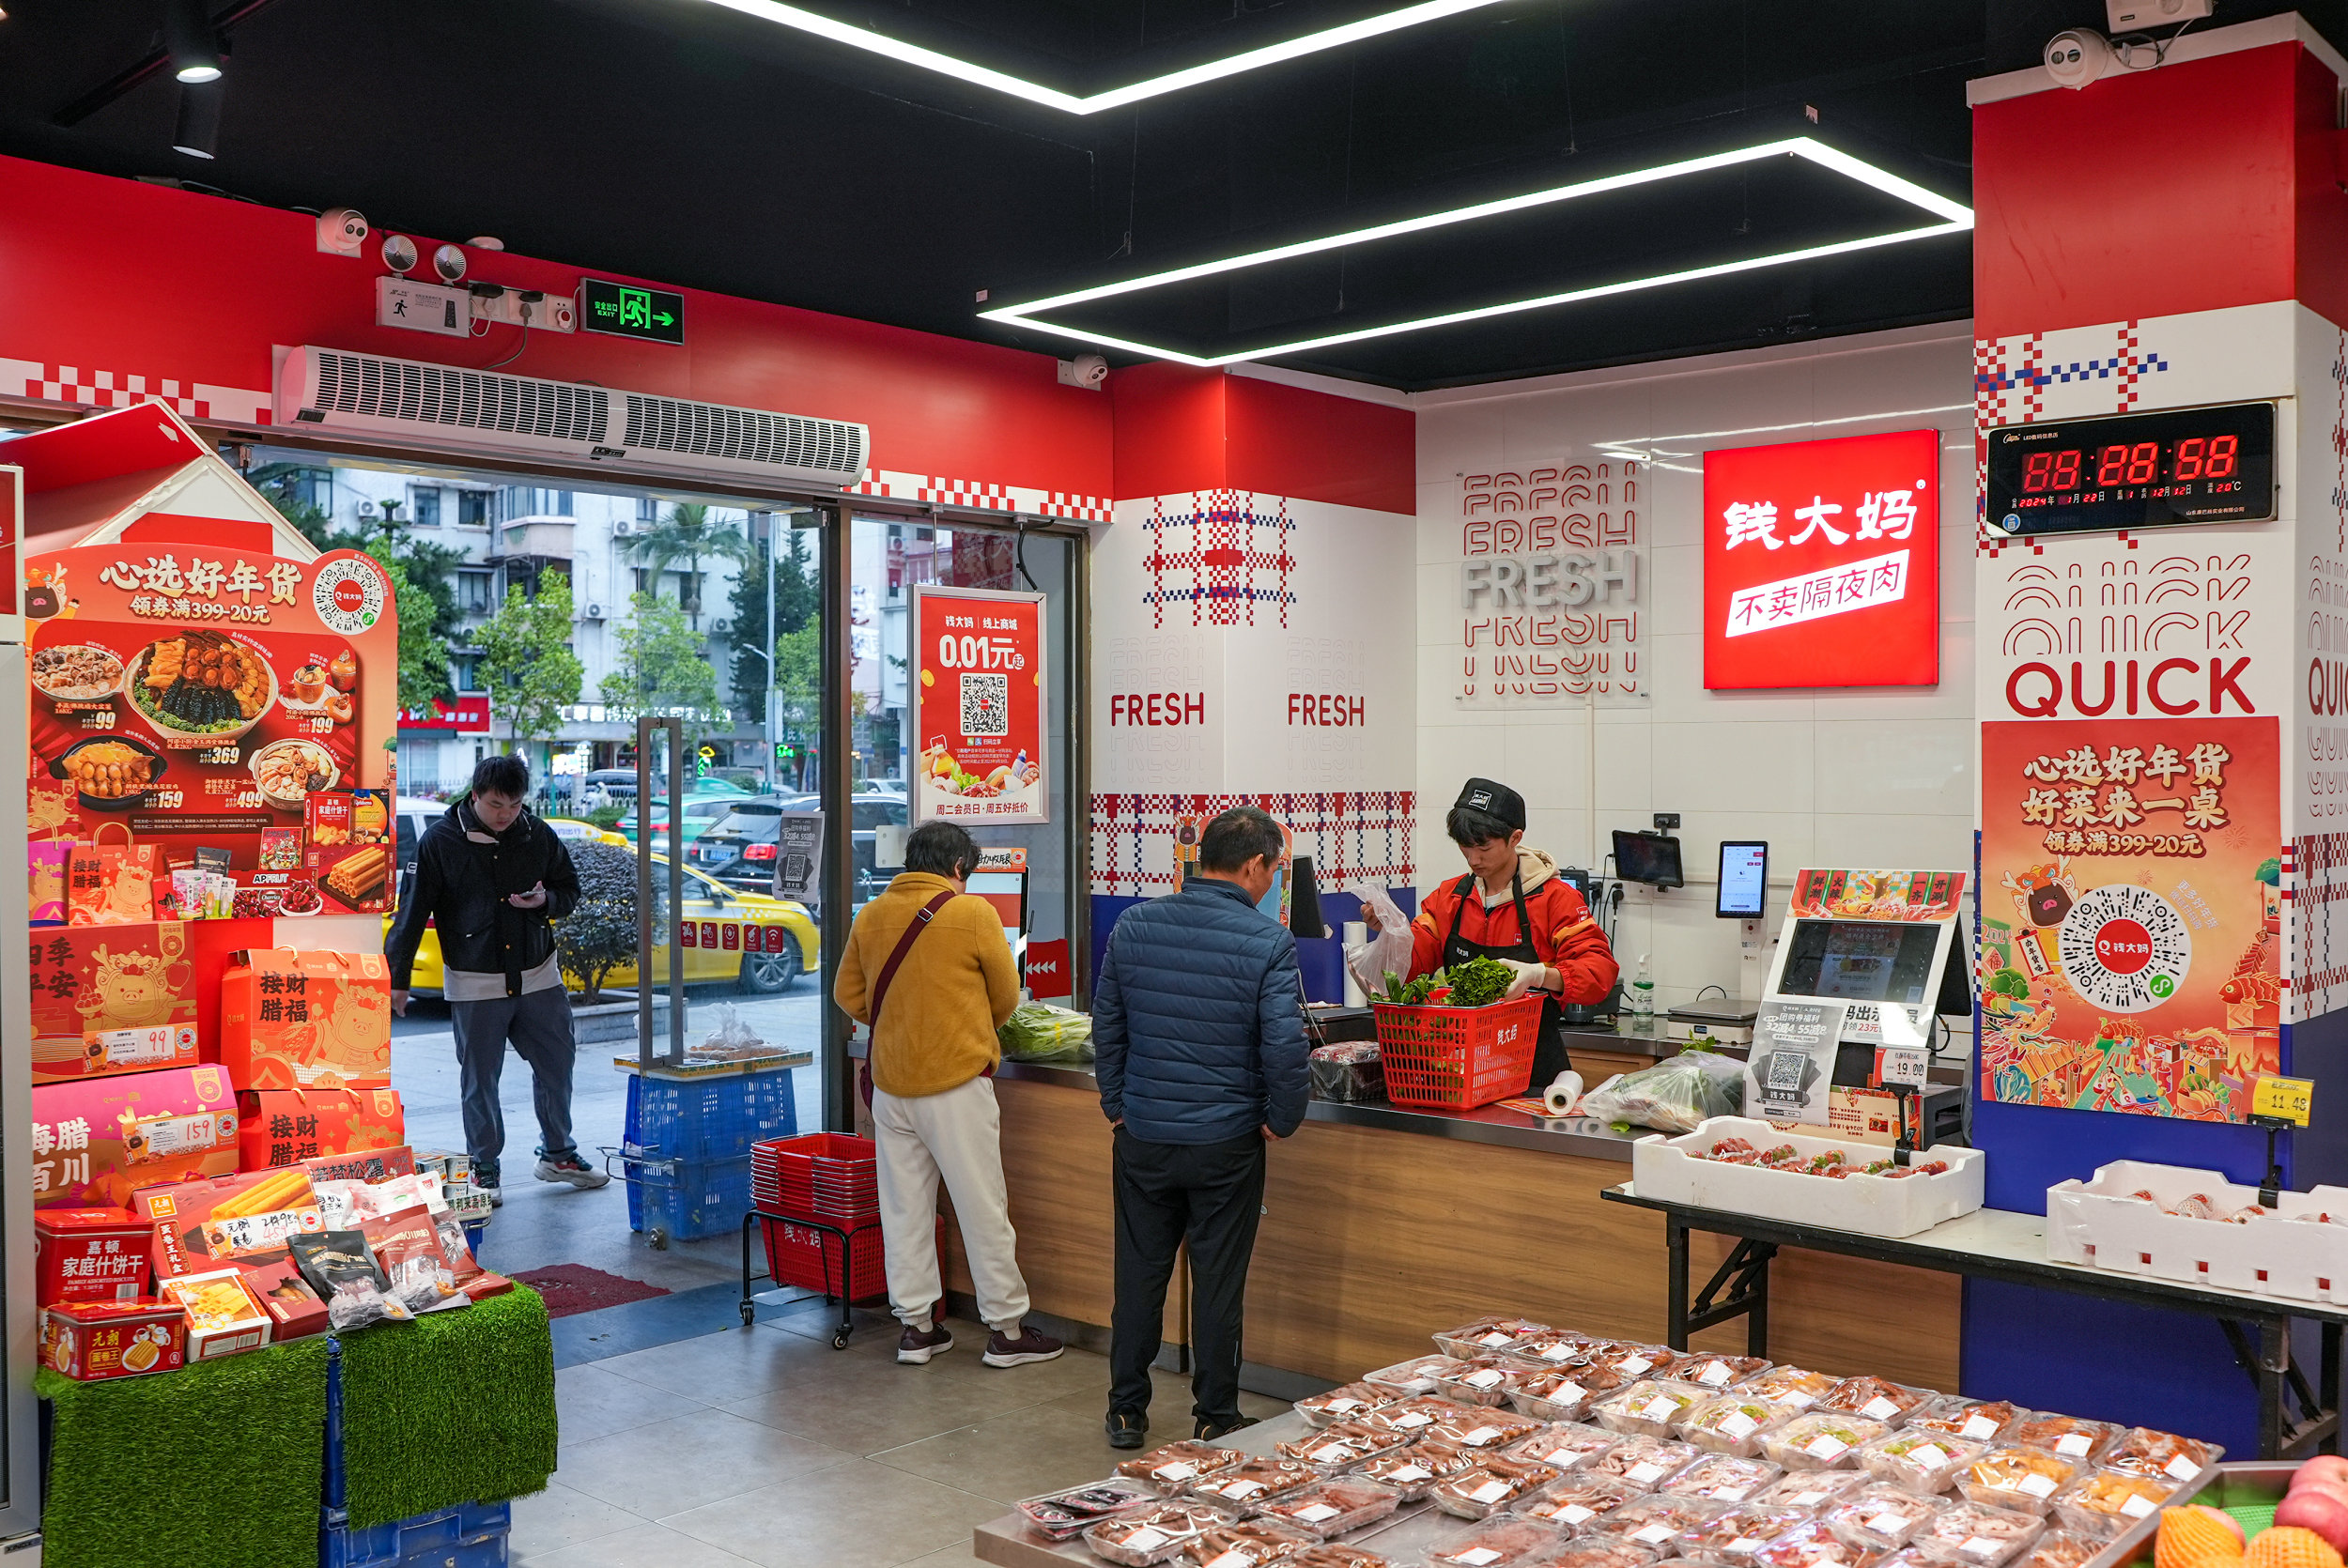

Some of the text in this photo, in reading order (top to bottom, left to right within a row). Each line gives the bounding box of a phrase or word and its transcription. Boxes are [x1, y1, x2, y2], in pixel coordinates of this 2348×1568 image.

[595, 301, 618, 312] 安全出口
[1725, 490, 1918, 550] 钱大妈
[100, 554, 302, 606] 心选好年货
[1460, 550, 1636, 608] FRESH
[1736, 560, 1901, 626] 不卖隔夜肉
[129, 594, 270, 623] 领券满399-20元
[945, 615, 1018, 631] 钱大妈 线上商城
[939, 634, 1015, 669] 0.01元
[2005, 656, 2256, 717] QUICK
[1111, 692, 1204, 727] FRESH
[1288, 693, 1365, 727] FRESH
[96, 712, 116, 730] 99
[310, 717, 334, 734] 199
[211, 747, 240, 764] 369
[2024, 742, 2230, 787] 心选好年货
[158, 791, 183, 808] 159
[236, 792, 264, 808] 499
[318, 806, 348, 815] 家庭什饼干
[2021, 785, 2227, 830] 好菜来一桌
[2043, 830, 2204, 856] 领券满399-20元
[72, 858, 101, 873] 接财
[72, 874, 101, 888] 腊福
[2176, 879, 2219, 930] 更多好年货
[1982, 924, 2013, 945] 2024
[2113, 943, 2149, 954] 钱大妈
[1988, 953, 2001, 970] 福
[260, 970, 309, 995] 接财
[259, 998, 309, 1023] 腊福
[1779, 1013, 1820, 1023] 团购券福利
[148, 1029, 167, 1053] 99
[1496, 1023, 1518, 1046] 钱大妈
[1896, 1062, 1924, 1076] 19.00
[1769, 1091, 1796, 1101] 钱大妈
[2271, 1094, 2307, 1112] 11.48
[186, 1119, 210, 1141] 159
[270, 1114, 319, 1139] 接财
[269, 1142, 320, 1167] 腊福
[86, 1239, 121, 1255] 嘉顿
[160, 1224, 184, 1273] 蛋卷王礼盒
[61, 1254, 144, 1278] 家庭什饼干
[92, 1329, 120, 1348] 元朗
[92, 1349, 119, 1363] 蛋卷王
